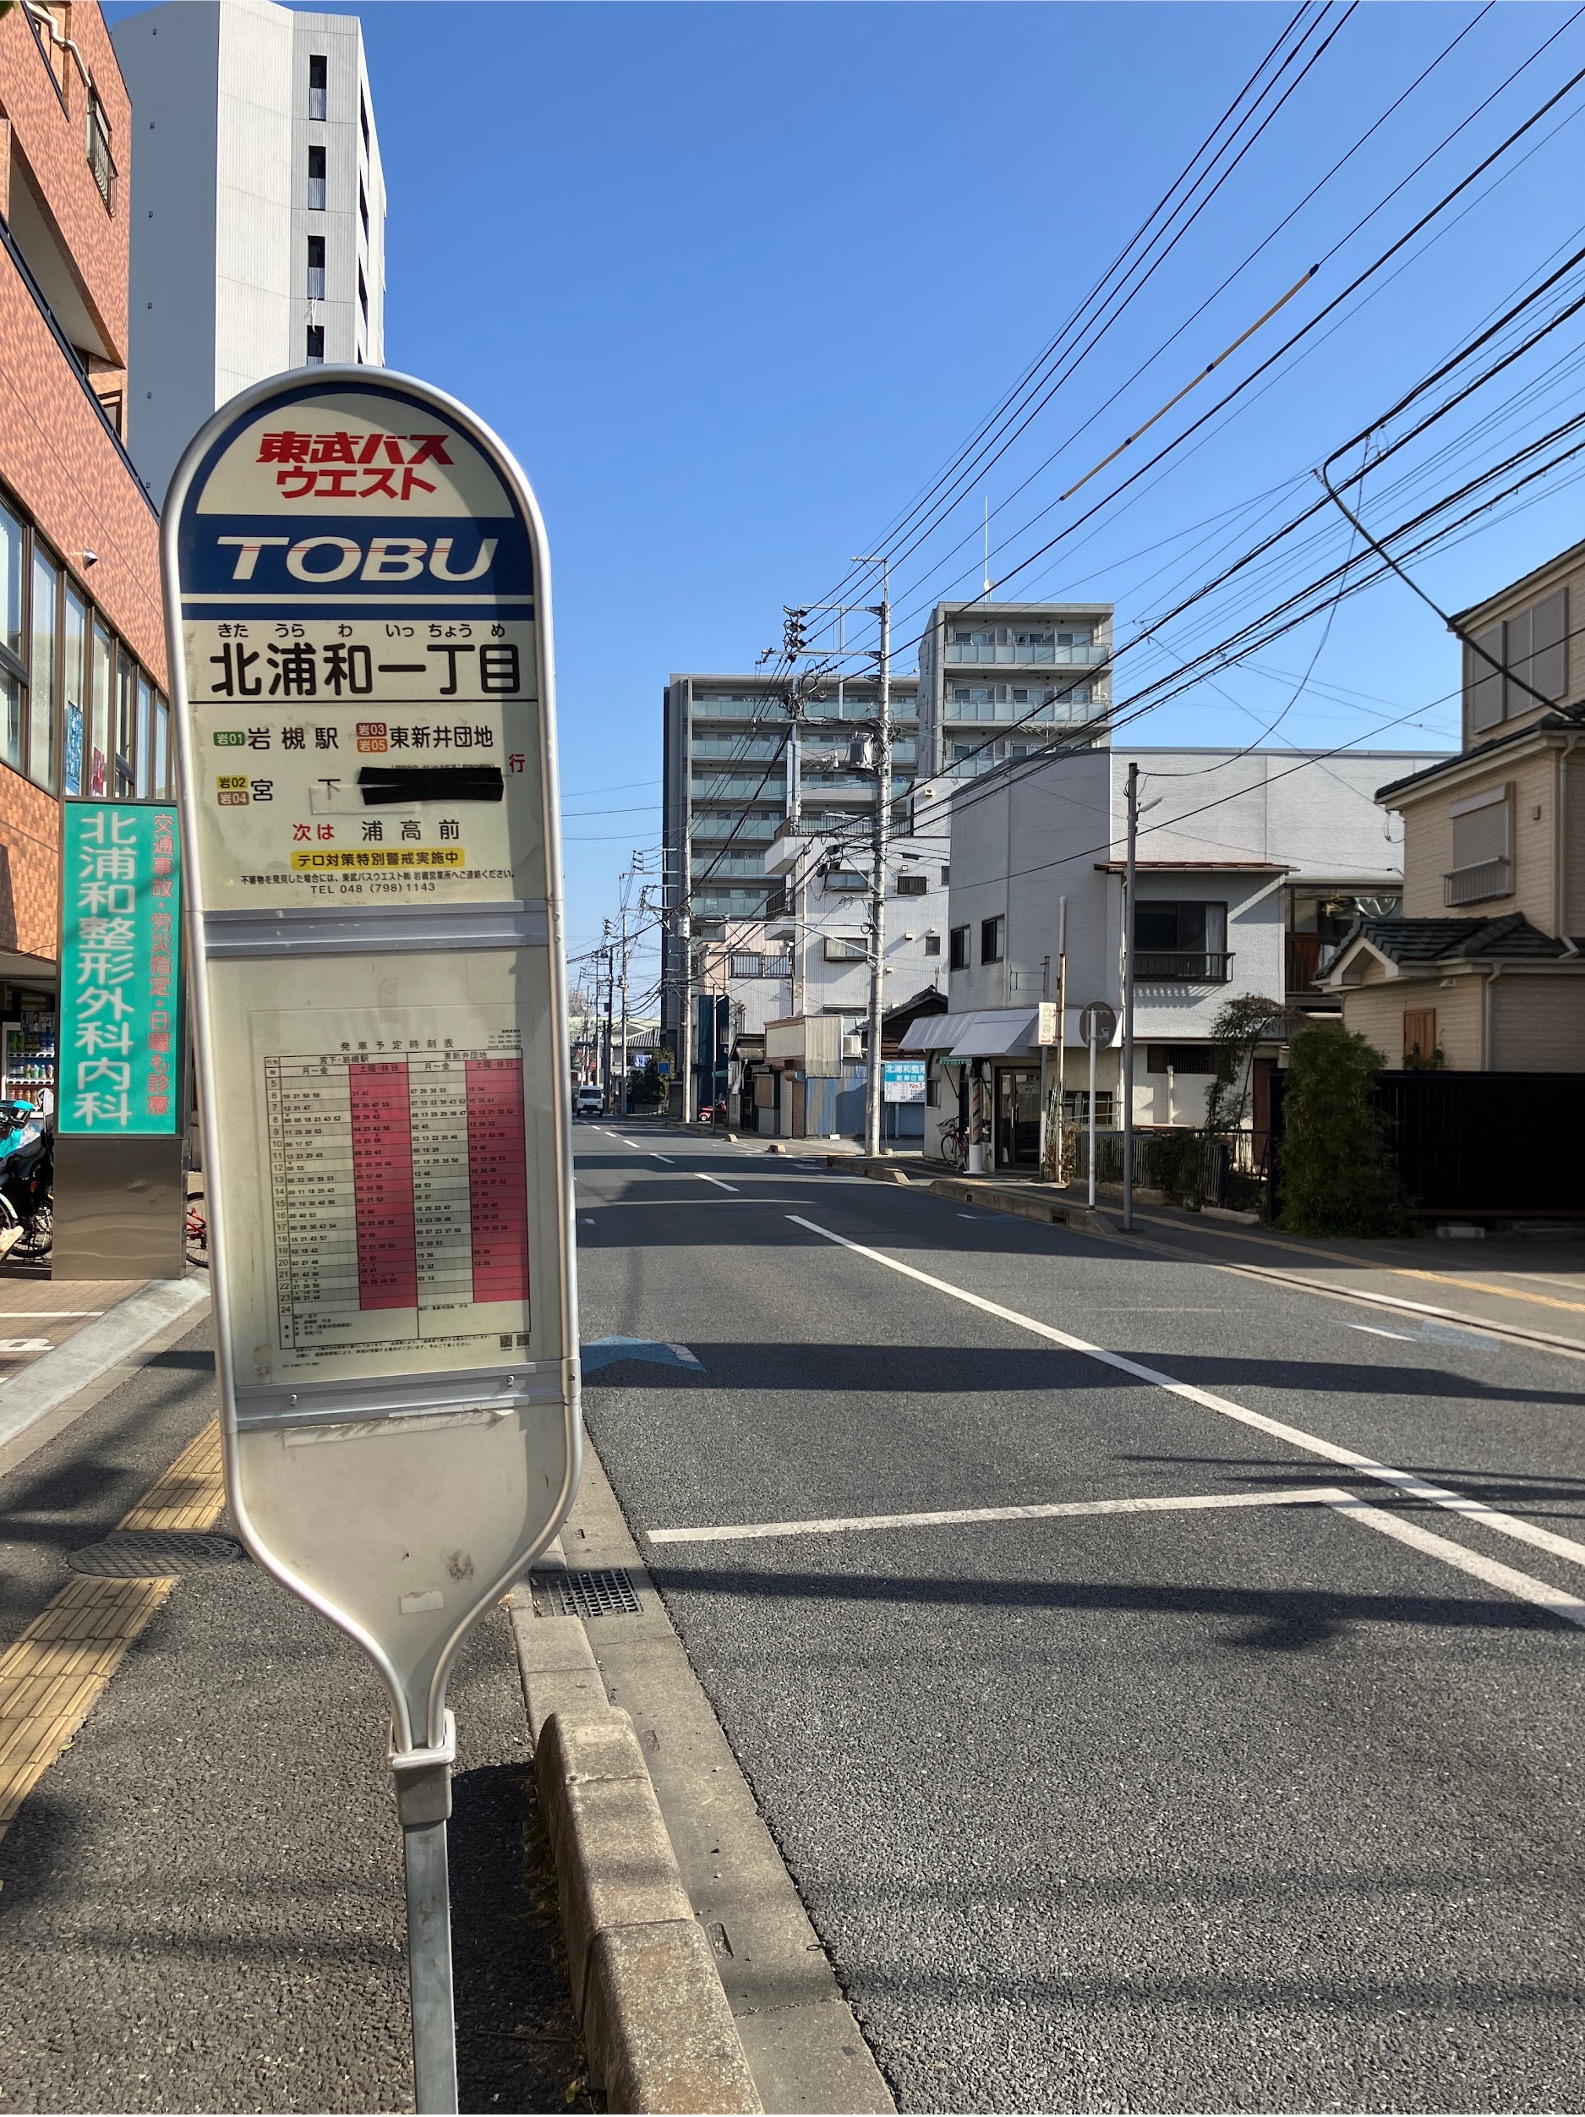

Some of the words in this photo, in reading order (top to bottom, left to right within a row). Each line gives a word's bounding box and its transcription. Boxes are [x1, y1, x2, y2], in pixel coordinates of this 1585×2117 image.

[256, 431, 454, 465] 東武バス
[276, 466, 436, 500] ウエスト
[217, 536, 499, 582] TOBU
[218, 624, 248, 638] きた
[276, 624, 304, 638] うら
[338, 624, 352, 638] わ
[386, 624, 414, 638] いっ
[429, 624, 472, 638] ちょう
[491, 624, 505, 638] め
[210, 642, 520, 696] 北浦和一丁目
[217, 733, 243, 745] 岩01
[248, 727, 338, 750] 岩槻駅
[358, 724, 385, 735] 岩03
[390, 725, 493, 749] 東新井団地
[358, 739, 386, 751] 岩05
[508, 754, 525, 773] 行
[219, 777, 246, 788] 岩02
[220, 792, 246, 804] 岩04
[293, 823, 335, 841] 次は
[362, 819, 460, 841] 浦高前
[298, 852, 458, 867] テロ対策特別警戒実施中
[311, 885, 335, 894] TEL
[340, 885, 362, 894] 048
[74, 811, 138, 1128] 北浦和整形外科内科
[340, 1039, 453, 1051] 発車予定時刻表
